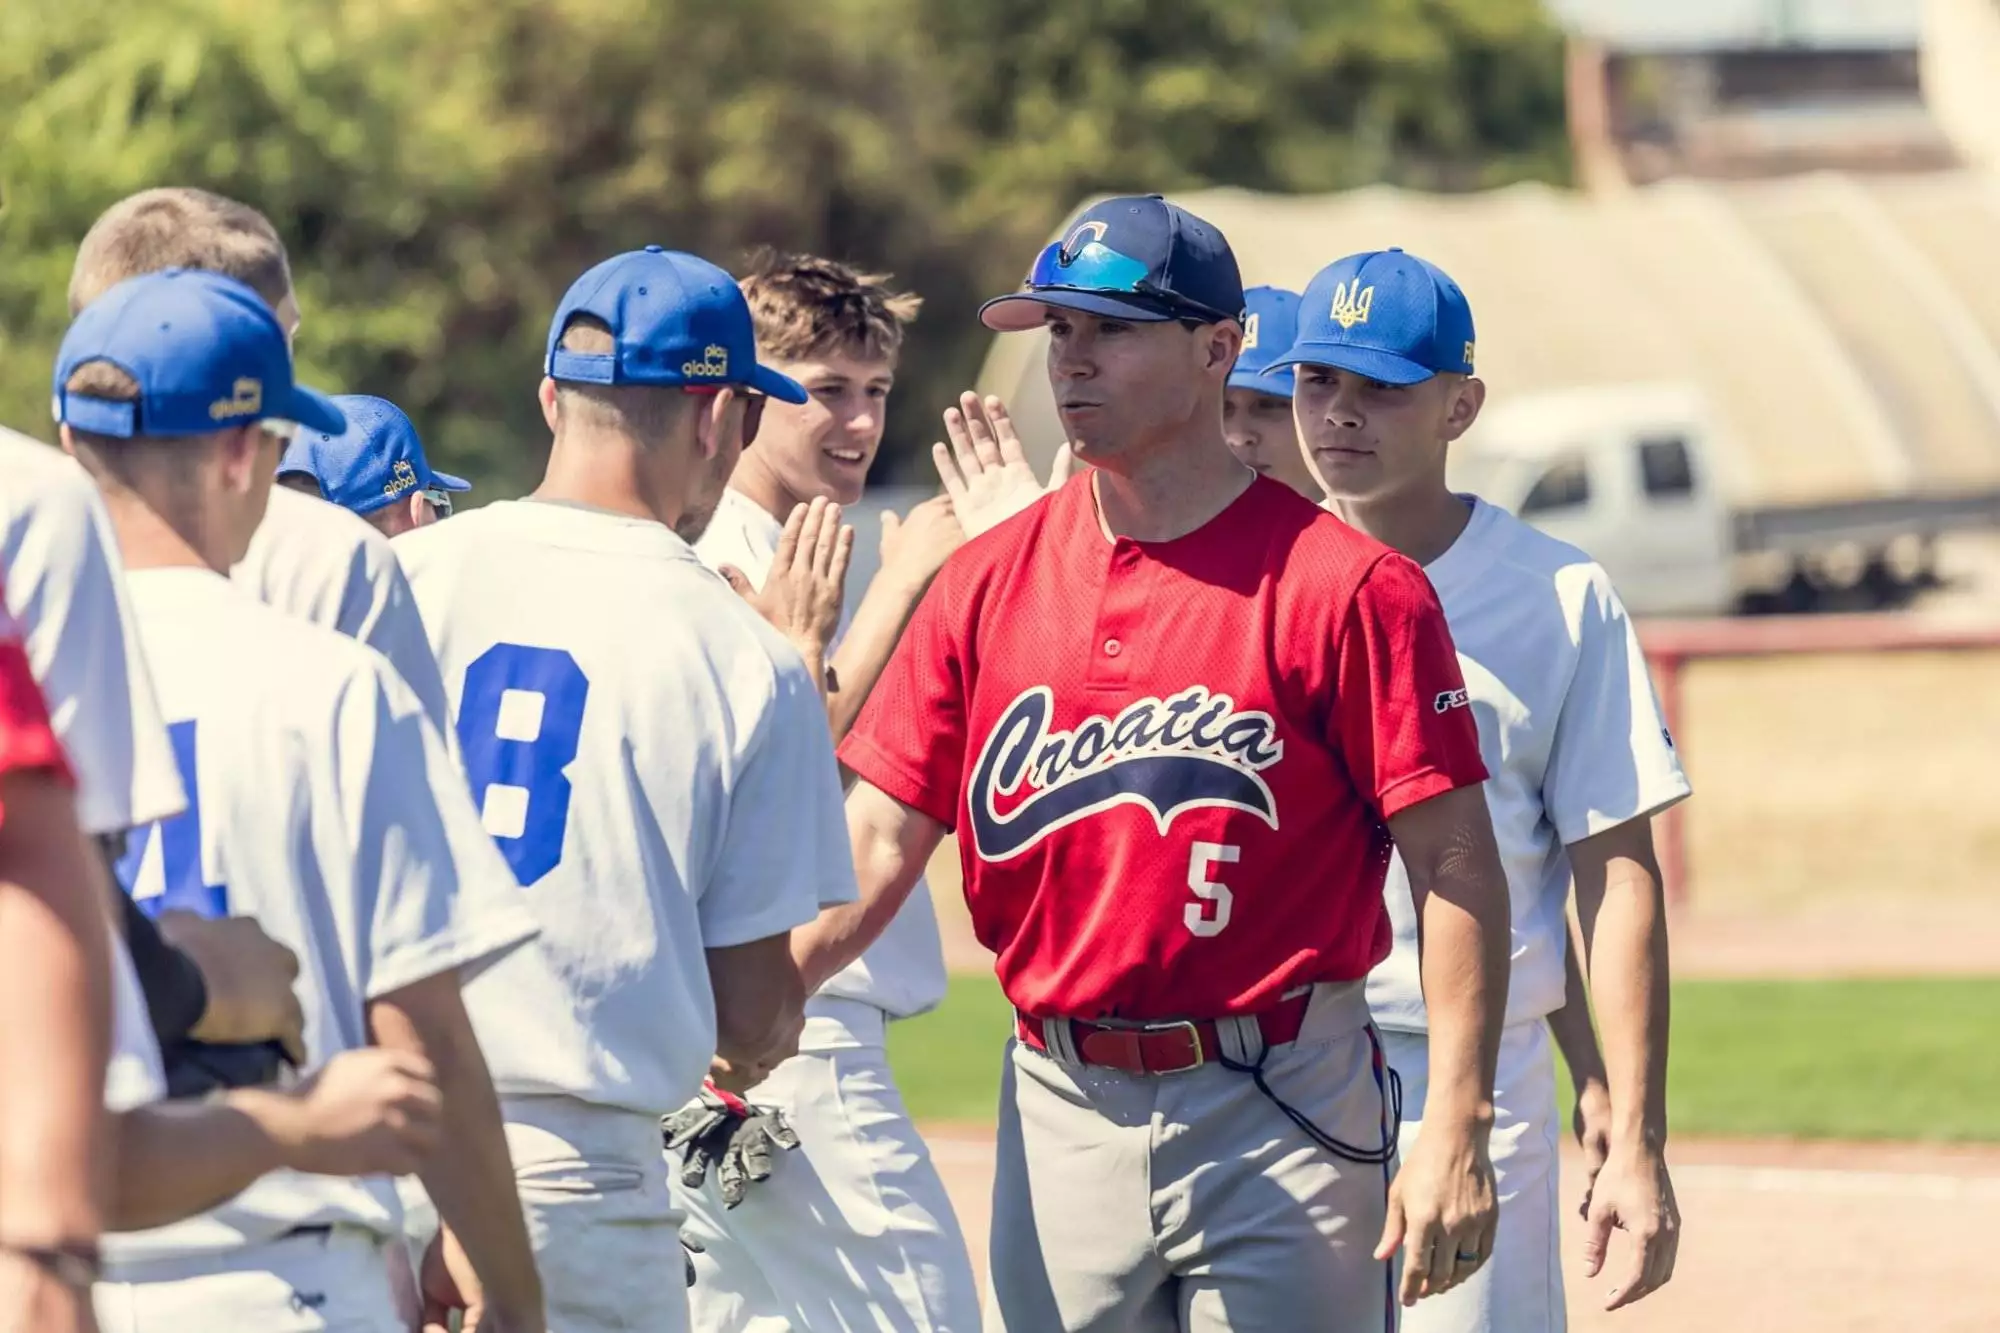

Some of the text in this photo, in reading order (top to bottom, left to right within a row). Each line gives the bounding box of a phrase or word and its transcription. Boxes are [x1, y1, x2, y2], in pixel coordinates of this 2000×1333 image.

[681, 356, 728, 378] global
[454, 641, 589, 887] 8
[967, 684, 1284, 863] Croatia
[1183, 840, 1241, 937] 5
